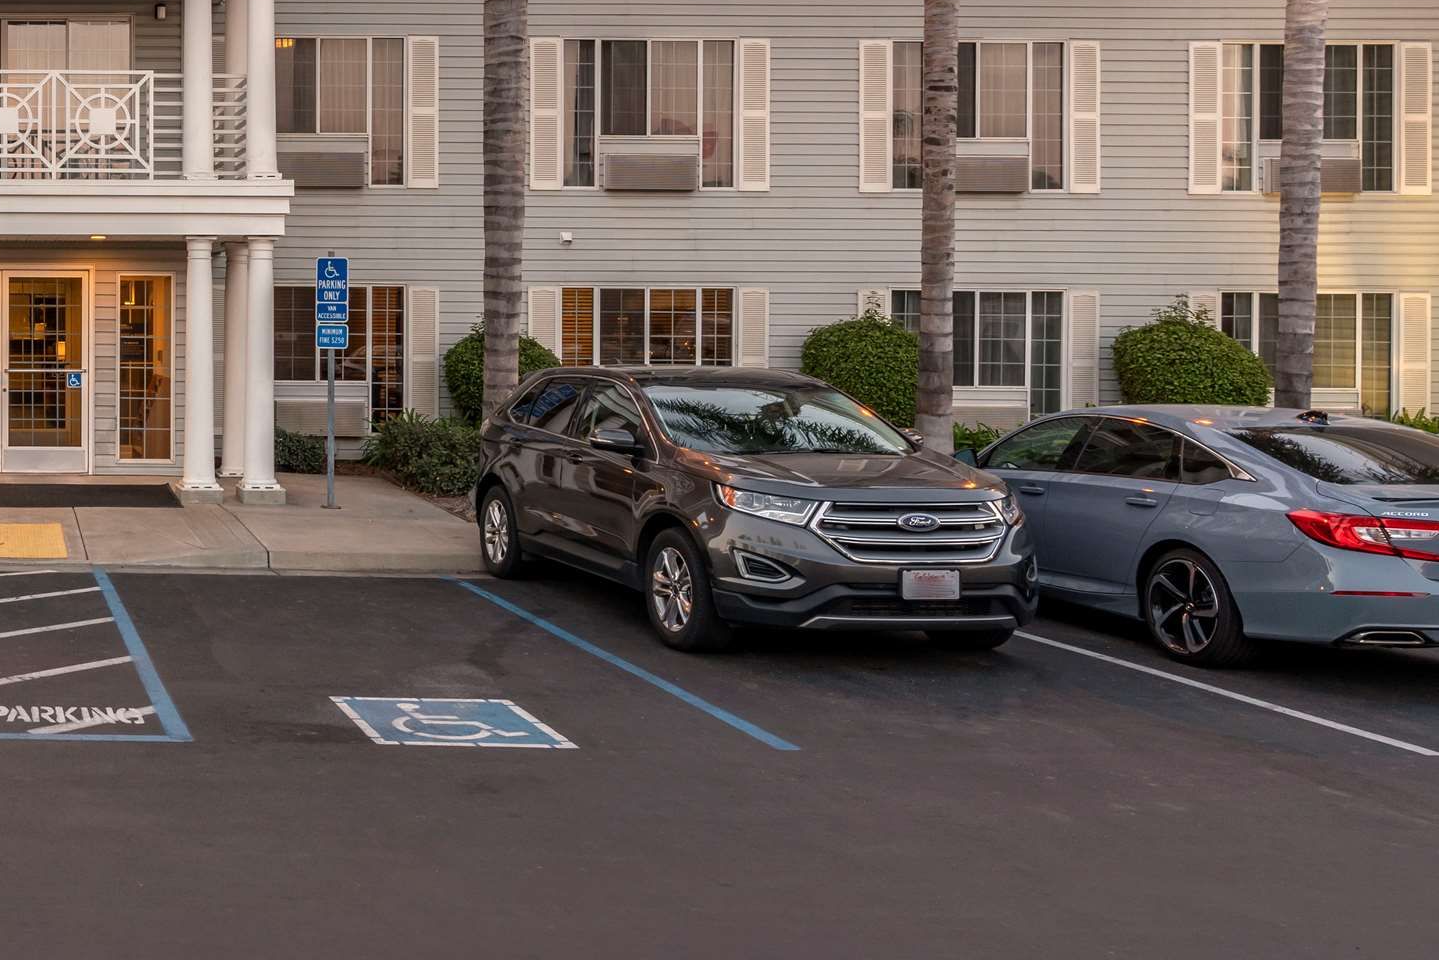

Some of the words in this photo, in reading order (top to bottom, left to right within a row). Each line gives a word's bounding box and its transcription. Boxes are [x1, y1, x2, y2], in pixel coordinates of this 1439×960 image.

[318, 279, 346, 289] PARKING
[323, 290, 340, 300] ONLY
[331, 336, 345, 344] $250
[909, 516, 932, 526] Ford
